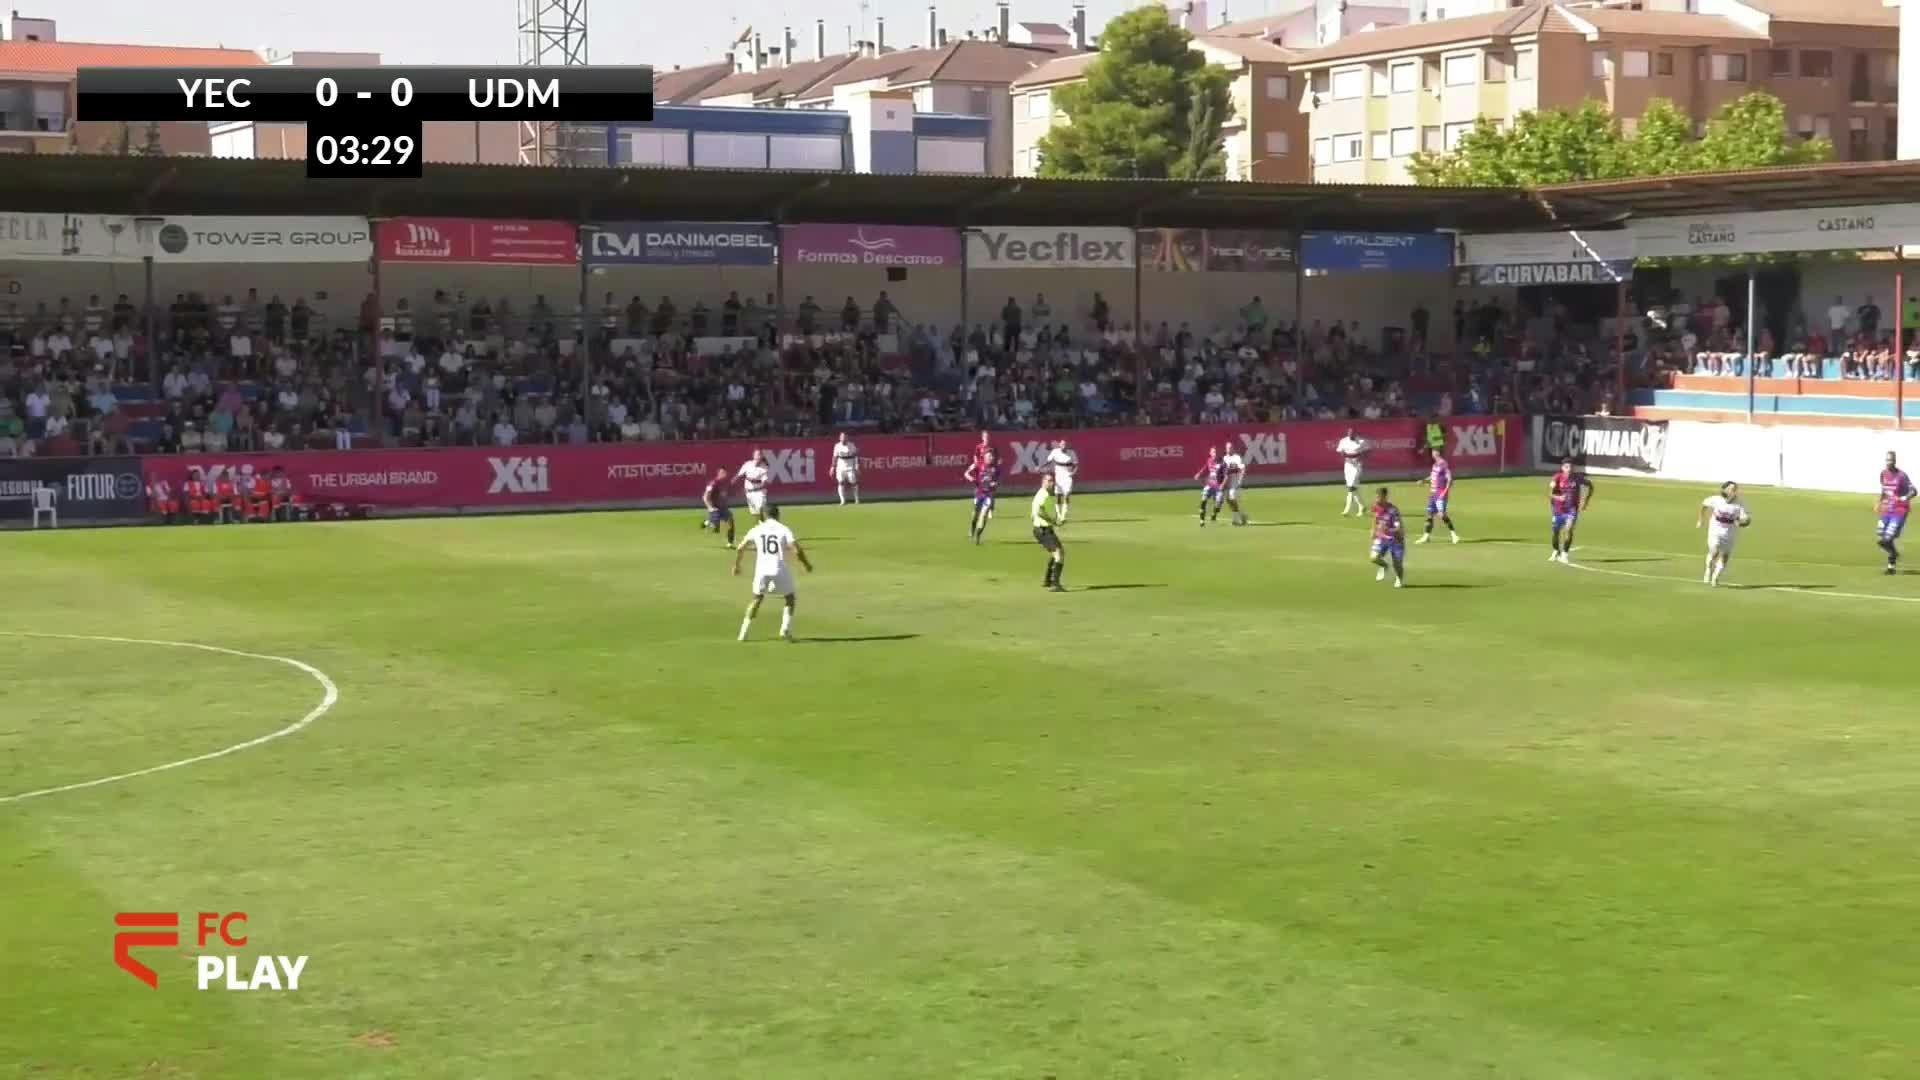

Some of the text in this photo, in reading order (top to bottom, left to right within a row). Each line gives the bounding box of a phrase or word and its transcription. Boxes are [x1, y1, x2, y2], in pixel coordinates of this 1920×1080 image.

[193, 232, 367, 245] TOWER GROUP
[646, 233, 773, 248] DANIMOBEL
[977, 232, 1125, 261] Yecflex
[1495, 264, 1593, 283] CURVABAR
[1240, 433, 1287, 464] Xti
[487, 456, 550, 494] Xti
[763, 448, 815, 483] Xti
[309, 471, 438, 488] THE URBAN BRAND
[760, 534, 779, 555] 16
